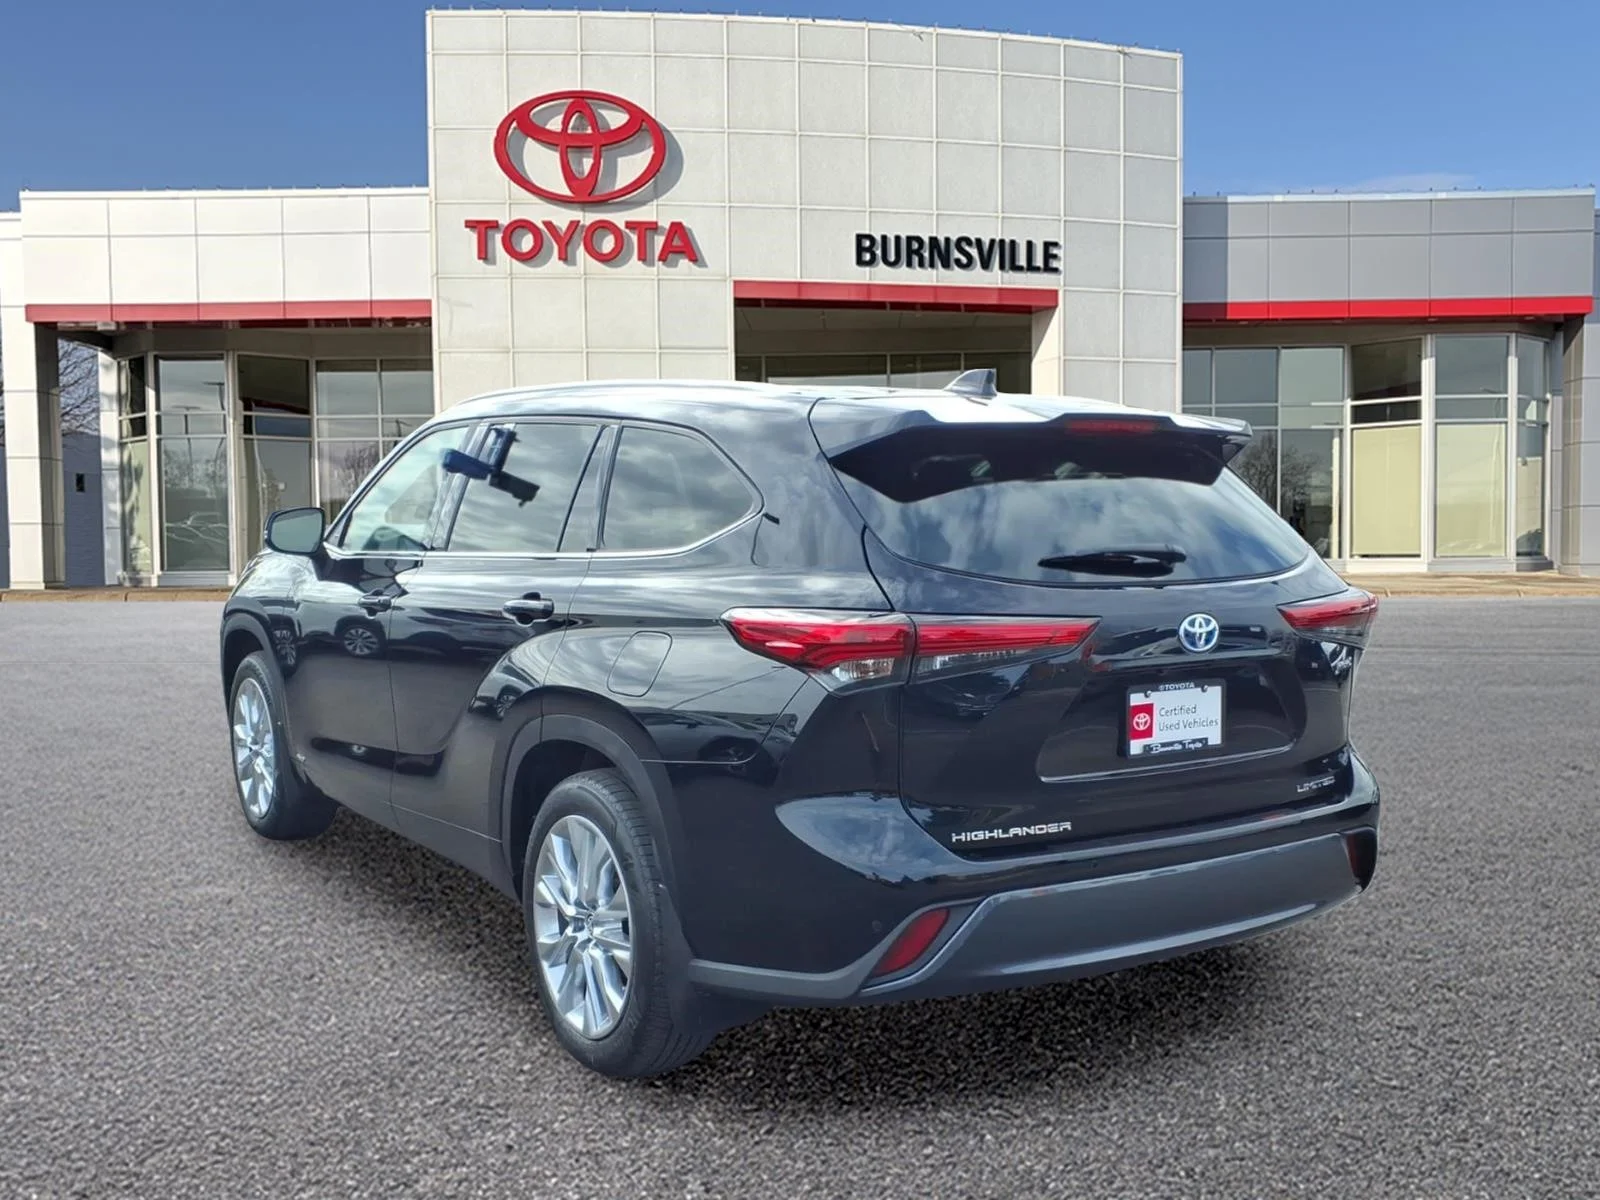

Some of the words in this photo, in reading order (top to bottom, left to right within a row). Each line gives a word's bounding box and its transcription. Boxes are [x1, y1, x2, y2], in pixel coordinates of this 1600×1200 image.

[464, 218, 699, 263] TOYOTA
[855, 233, 1061, 273] BURNSVILLE
[1164, 682, 1195, 691] TOYOTA
[1159, 704, 1197, 717] Certified
[1159, 719, 1180, 731] Used
[1182, 717, 1219, 730] Vehicles
[951, 821, 1072, 842] HIGHLANDER
